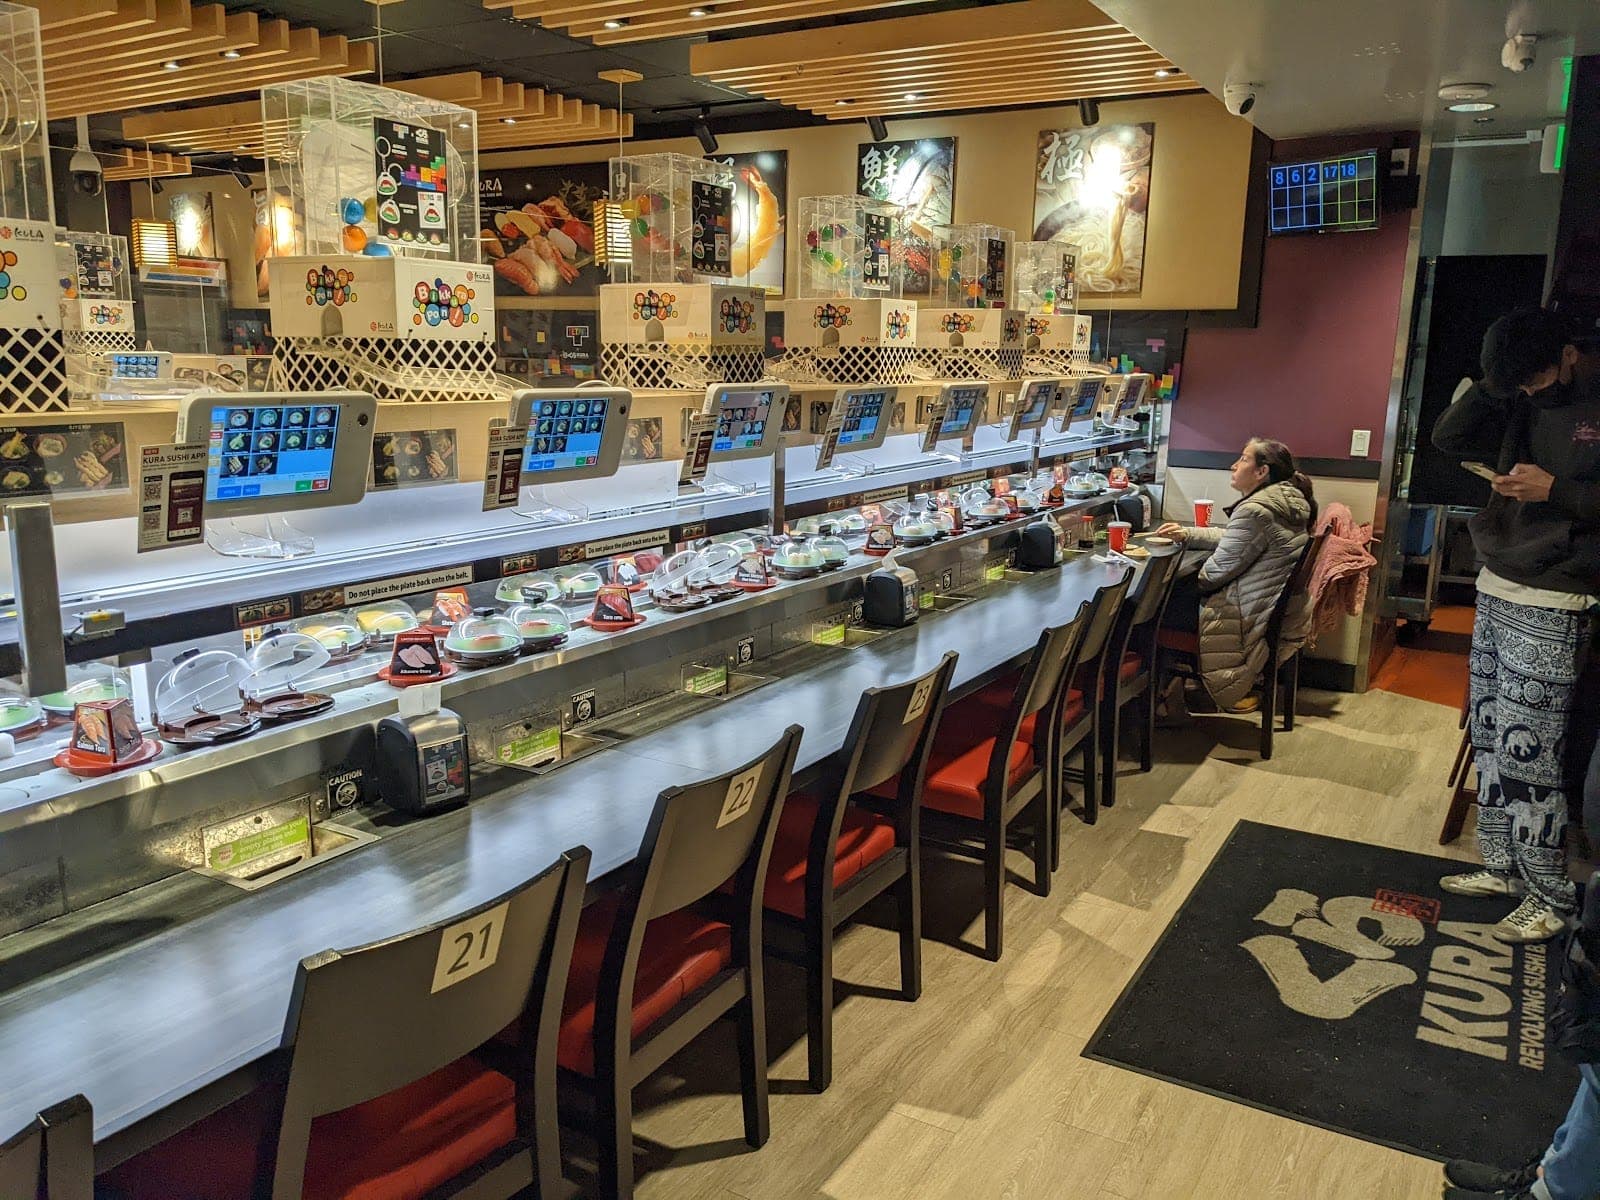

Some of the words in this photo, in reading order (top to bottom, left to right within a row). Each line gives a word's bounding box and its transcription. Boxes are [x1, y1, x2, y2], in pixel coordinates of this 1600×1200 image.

[1275, 171, 1284, 185] 8
[1291, 169, 1300, 183] 6
[1307, 167, 1317, 182] 2
[1323, 165, 1338, 178] 17
[1340, 163, 1356, 177] 18
[142, 456, 165, 465] KURA
[166, 454, 189, 462] SUSHI
[190, 452, 206, 460] APP
[348, 591, 358, 599] Do
[359, 589, 370, 597] not
[371, 587, 388, 596] place
[388, 584, 399, 592] the
[400, 582, 416, 591] plate
[417, 578, 431, 587] back
[432, 576, 445, 584] onto
[455, 571, 469, 579] belt.
[573, 690, 595, 702] CAUTION
[909, 684, 930, 714] 23
[329, 769, 363, 786] CAUTION
[725, 776, 755, 816] 22
[446, 921, 493, 976] 21
[1522, 952, 1548, 988] SUSHI
[1415, 920, 1514, 1061] KURA
[1518, 988, 1547, 1071] REVOLVING
